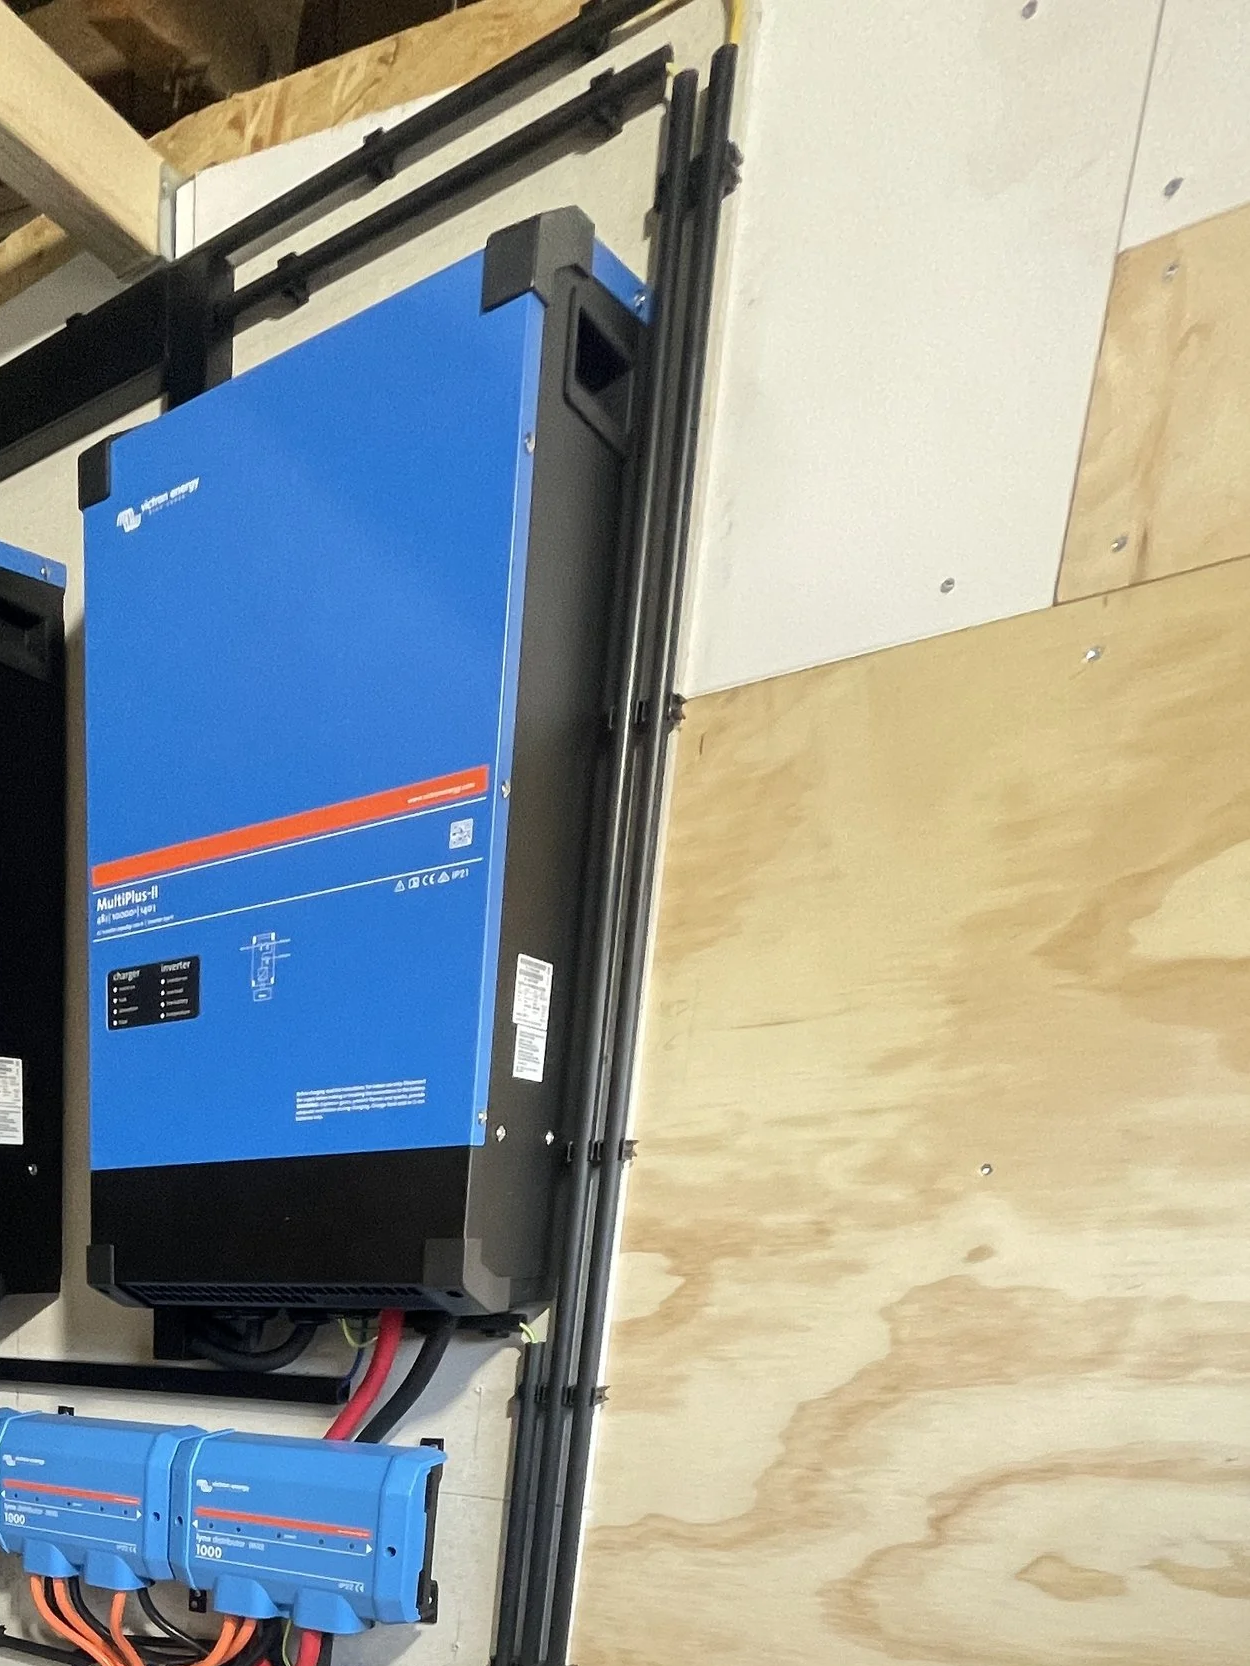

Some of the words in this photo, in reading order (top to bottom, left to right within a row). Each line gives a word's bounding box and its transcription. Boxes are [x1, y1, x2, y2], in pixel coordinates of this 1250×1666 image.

[140, 492, 169, 512] victron
[170, 476, 200, 494] energy
[96, 884, 159, 912] MultiPlus-II
[160, 961, 192, 973] inverter
[112, 969, 141, 982] charger
[4, 1512, 26, 1525] 1000
[195, 1543, 223, 1559] 1000
